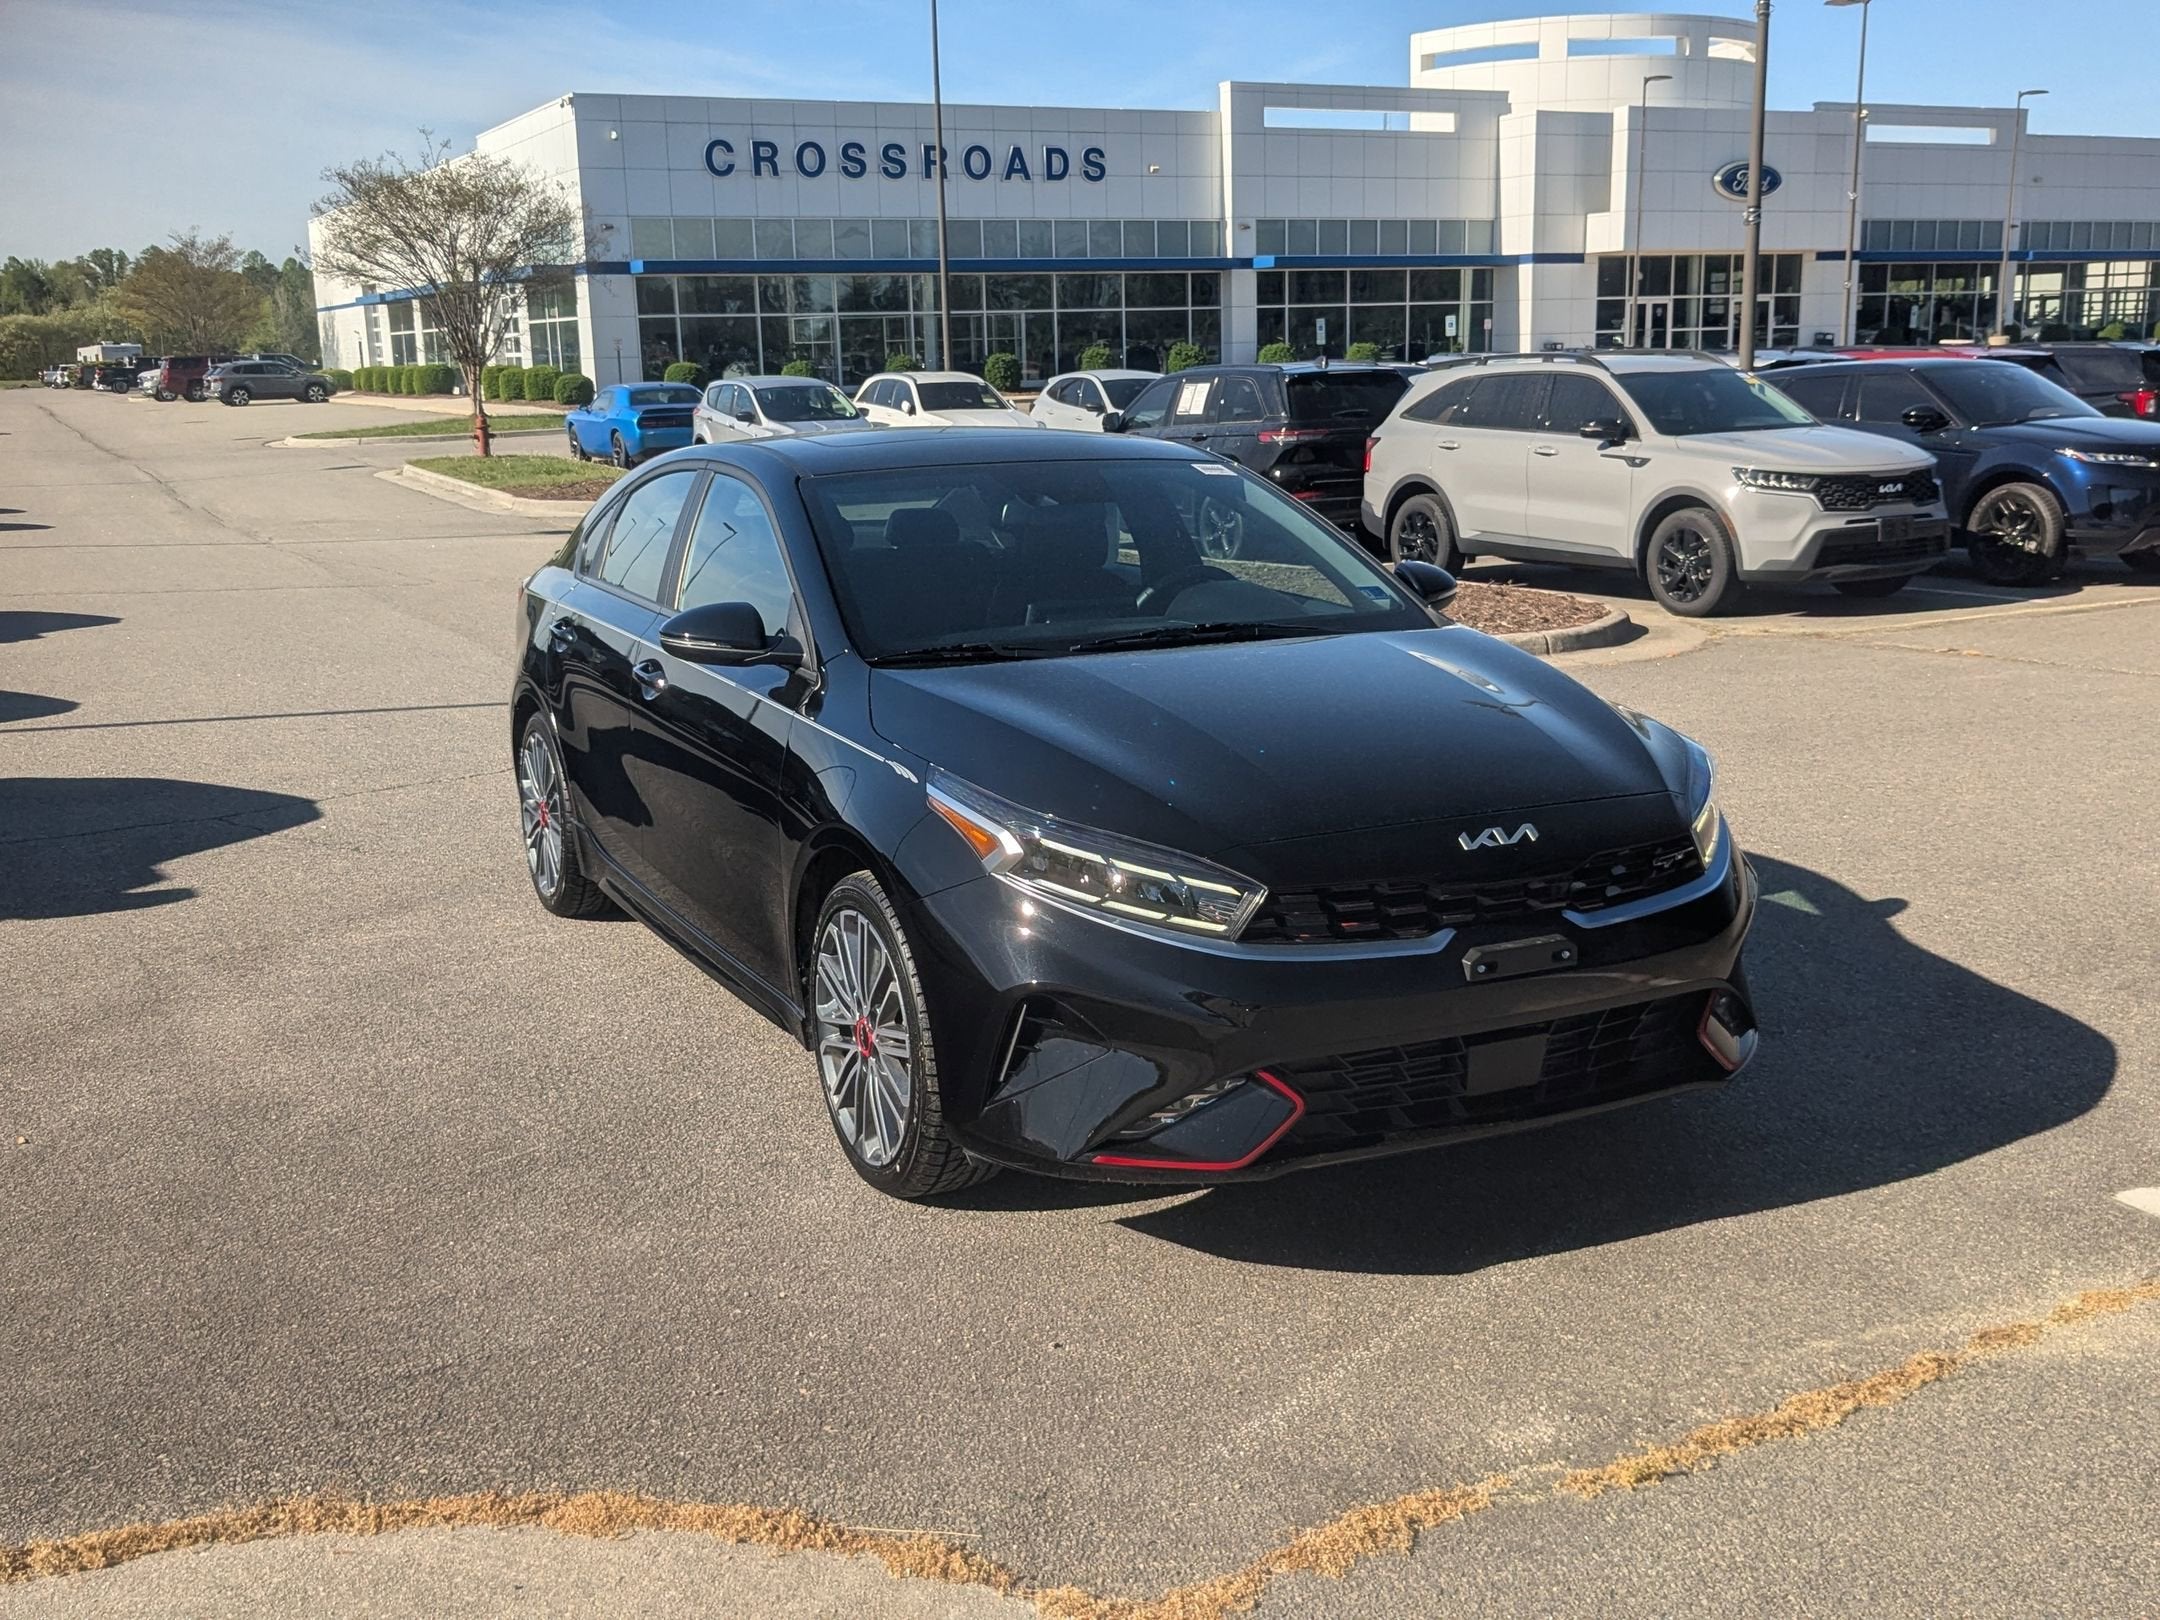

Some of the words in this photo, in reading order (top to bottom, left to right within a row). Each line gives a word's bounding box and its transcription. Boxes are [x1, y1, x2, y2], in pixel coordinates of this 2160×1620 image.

[703, 139, 1107, 182] CROSSROADS
[1879, 483, 1903, 493] KIA
[1458, 823, 1539, 850] KIA
